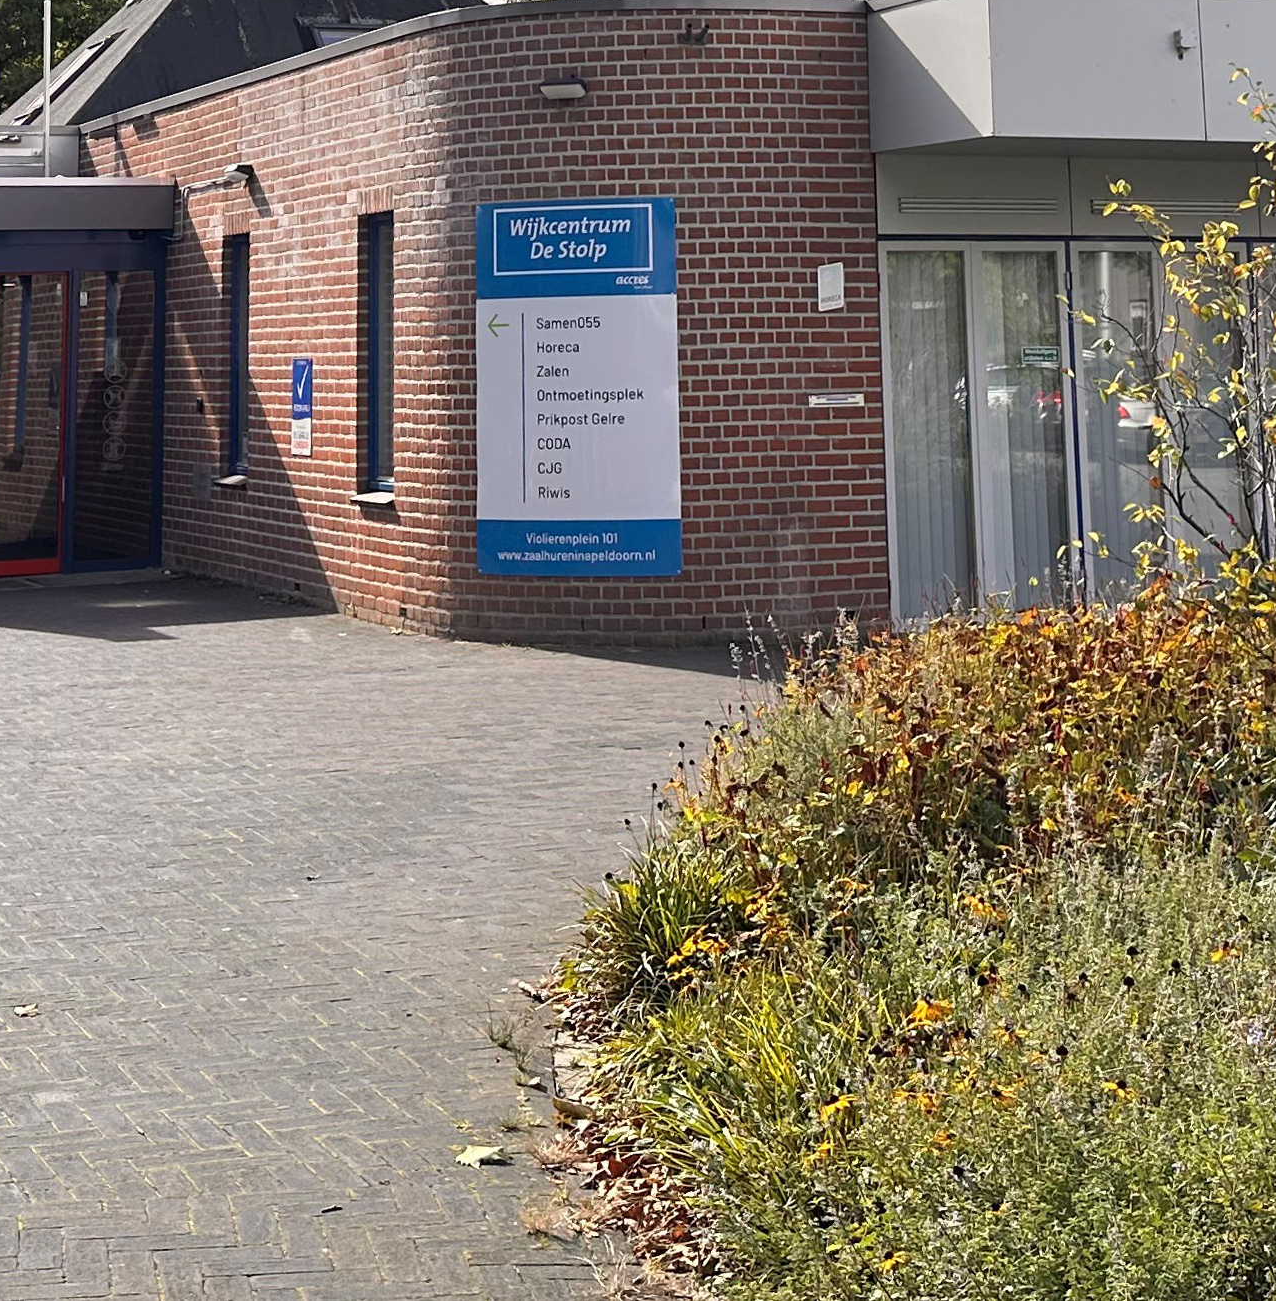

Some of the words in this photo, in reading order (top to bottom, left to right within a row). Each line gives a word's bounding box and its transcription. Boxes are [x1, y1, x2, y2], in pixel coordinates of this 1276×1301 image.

[510, 216, 631, 242] Wijkcentrum
[530, 242, 554, 259] De
[558, 238, 607, 263] Stolp
[536, 316, 601, 330] Samen055
[536, 341, 580, 353] Horeca
[536, 365, 569, 378] Zalen
[536, 388, 644, 404] Ontmoetingsplek
[536, 413, 588, 428] Prikpost
[591, 412, 625, 425] Gelre
[537, 437, 571, 450] CODA
[537, 461, 563, 475] CJG
[538, 486, 571, 499] Riwis
[526, 532, 600, 547] Violierenplein
[601, 532, 619, 545] 101
[497, 549, 656, 564] www.zaalhureninapeldoorn.nl
